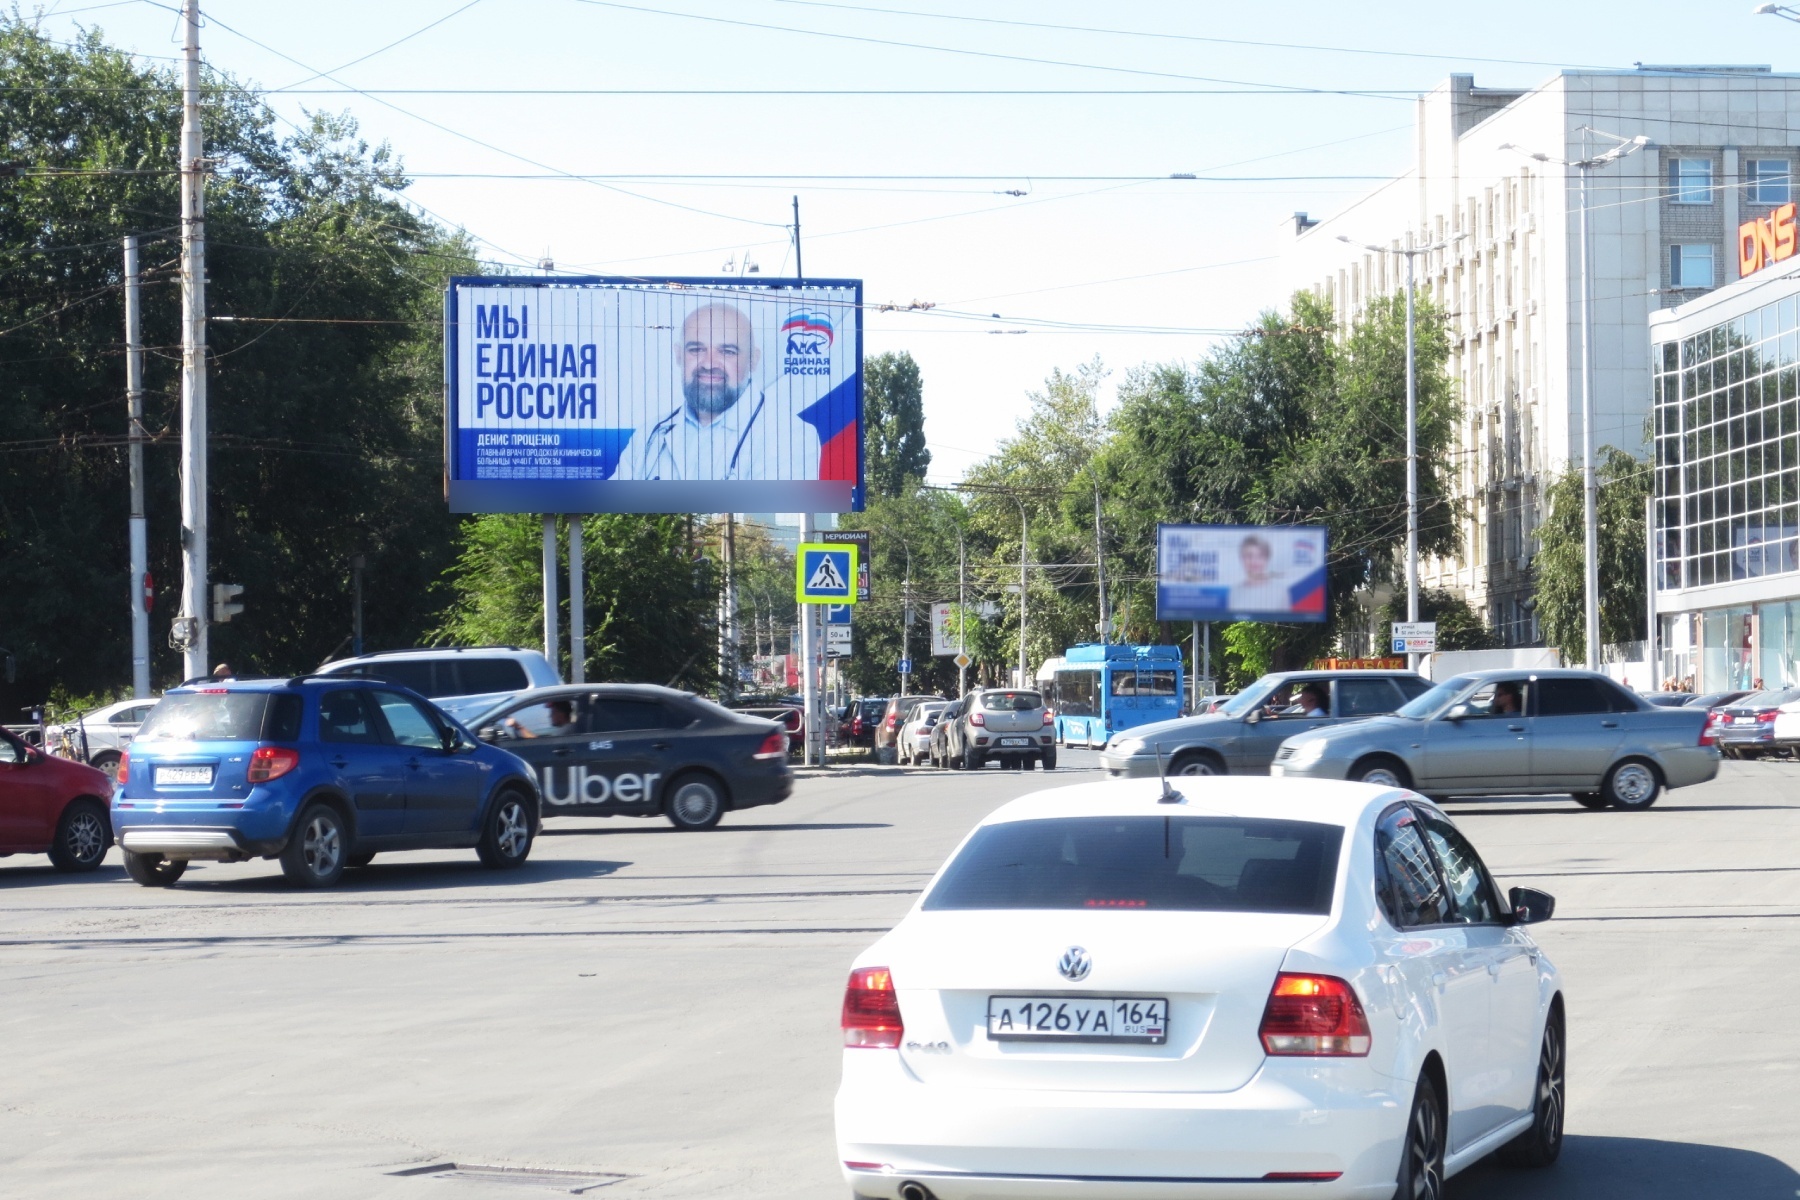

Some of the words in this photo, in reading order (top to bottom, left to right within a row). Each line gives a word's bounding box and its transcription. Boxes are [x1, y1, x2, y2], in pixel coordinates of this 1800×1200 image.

[1739, 203, 1797, 278] DNS
[476, 304, 528, 339] МЫ
[476, 343, 597, 382] ЕДИНАЯ
[784, 357, 830, 366] ЕДИНАЯ
[784, 367, 830, 375] РОССИЯ
[476, 382, 597, 419] РОССИЯ
[477, 434, 509, 446] ДЕНИС
[511, 434, 560, 447] ПРОЦЕНКО
[476, 448, 506, 457] ГЛАВНЫЙ
[522, 448, 558, 457] ГОРОДСКОЙ
[559, 448, 602, 457] КЛИНИЧЕСКОЙ
[476, 457, 510, 466] БОЛЬНИЦЫ
[1338, 660, 1401, 669] ТАБАК
[543, 766, 661, 806] Uber
[998, 1002, 1109, 1032] А126УА
[1116, 1002, 1159, 1025] 164
[1124, 1025, 1146, 1034] RUS
